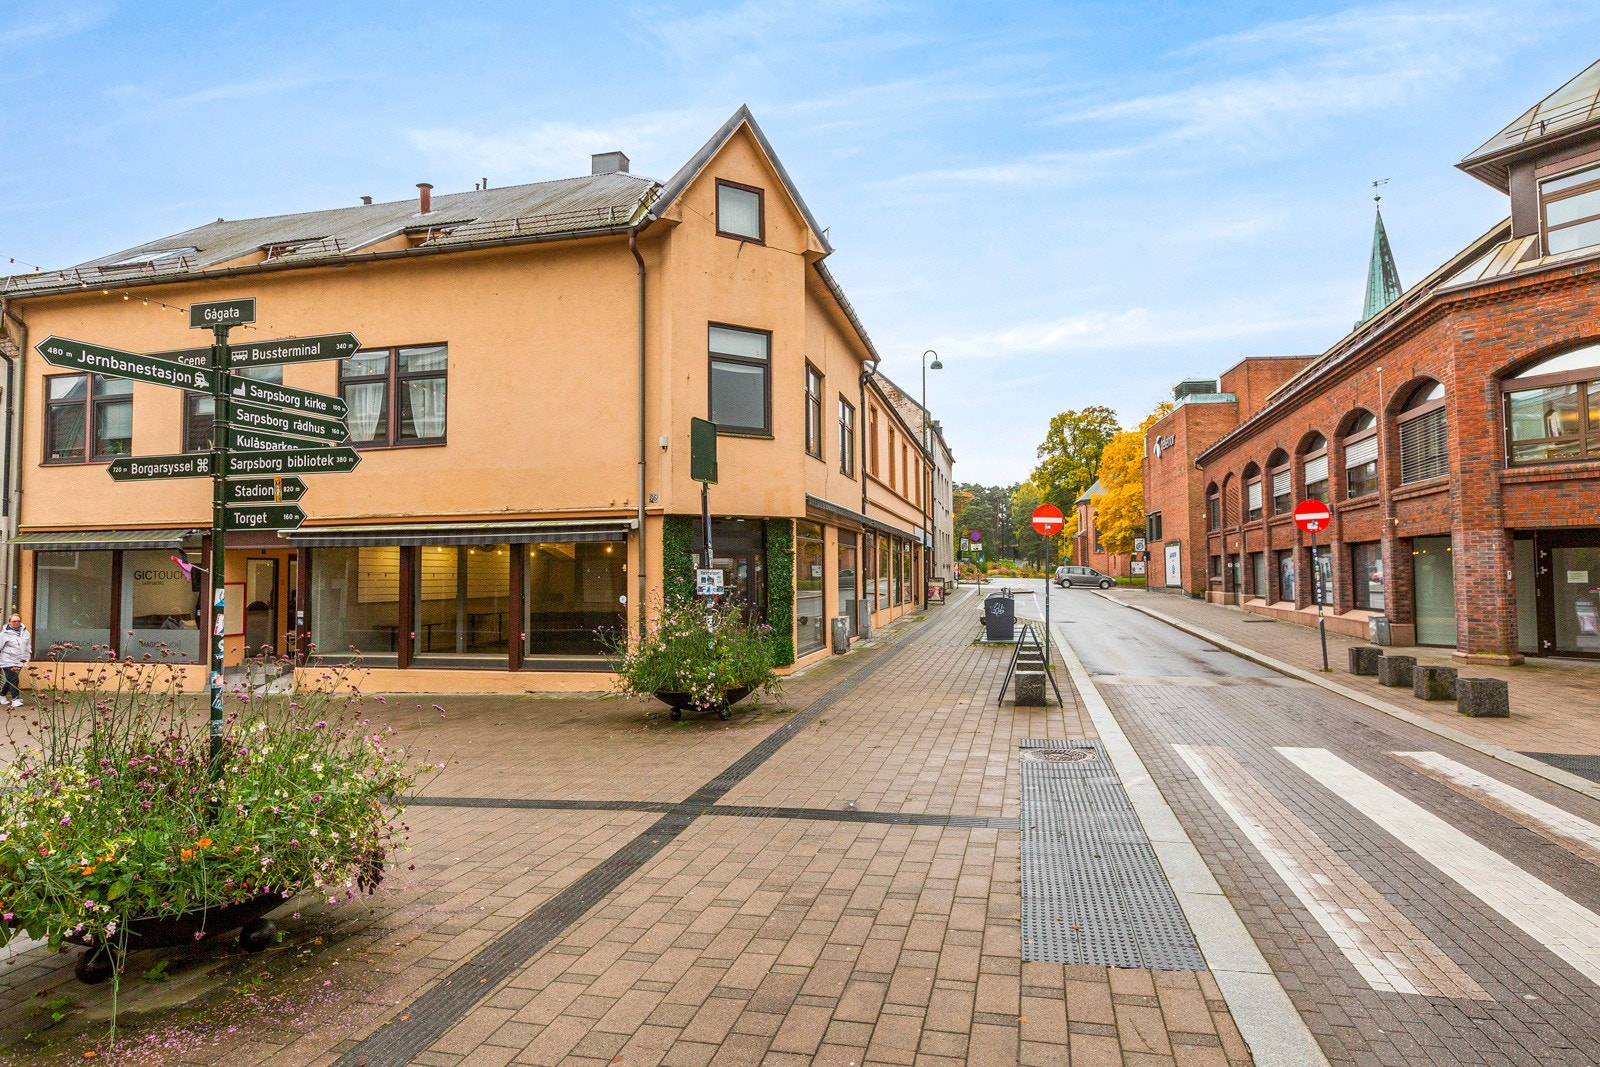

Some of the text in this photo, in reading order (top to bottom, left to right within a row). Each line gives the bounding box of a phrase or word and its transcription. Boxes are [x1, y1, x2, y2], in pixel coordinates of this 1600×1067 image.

[204, 307, 240, 322] Gågata
[252, 343, 321, 361] Bussterminal
[47, 347, 63, 356] 480
[77, 350, 192, 384] Jernbanestasjon
[177, 355, 206, 366] Scene
[250, 385, 300, 408] Sarpsborg
[304, 396, 328, 411] kirke
[236, 409, 289, 431] Sarpsborg
[293, 421, 326, 434] rådhus
[131, 461, 193, 476] Borgarsyssel
[230, 457, 283, 472] Sarpsborg
[287, 455, 334, 469] bibliotek
[235, 484, 274, 497] Stadion
[234, 512, 267, 526] Torget
